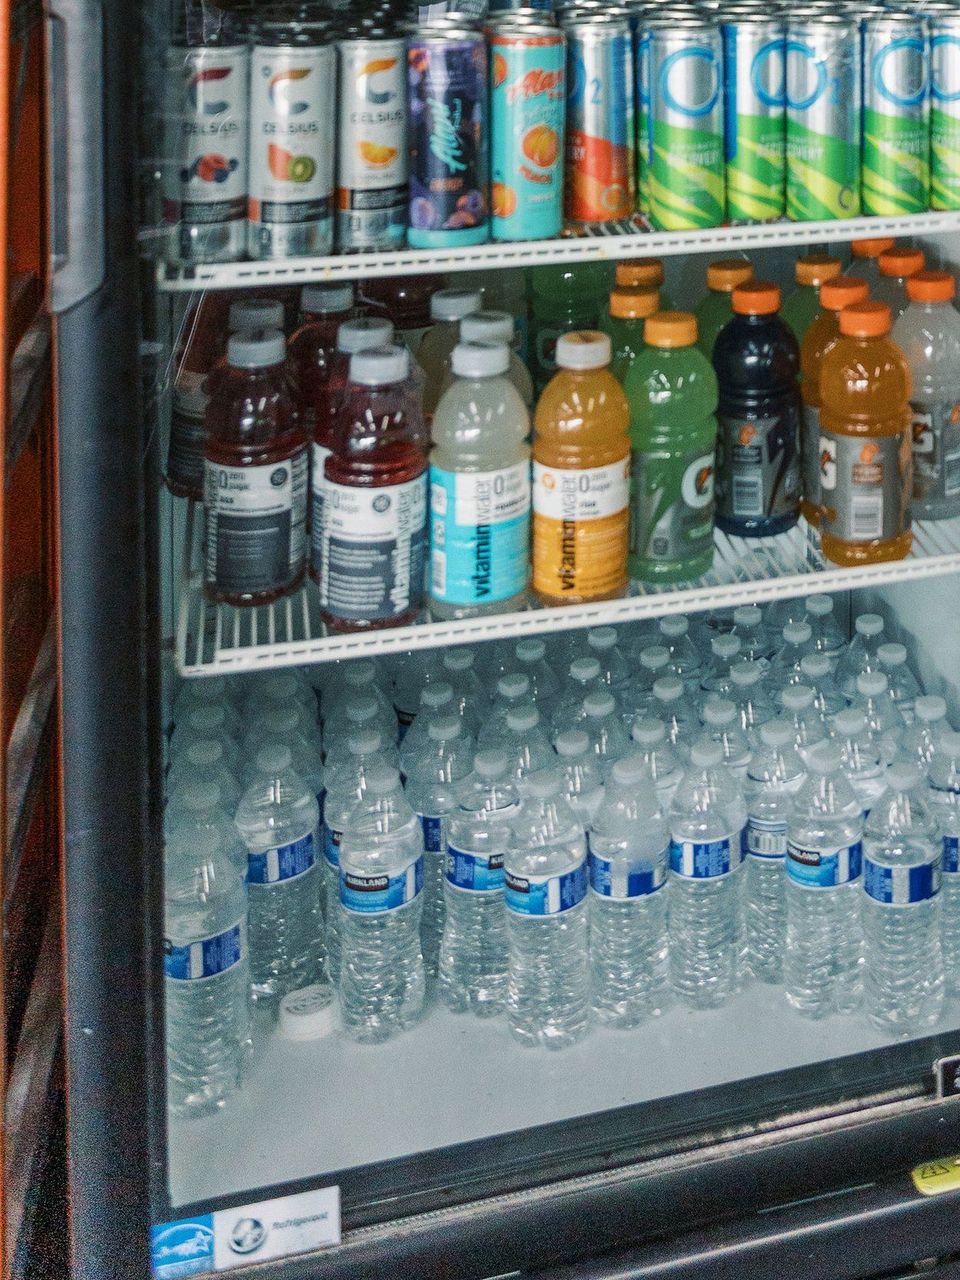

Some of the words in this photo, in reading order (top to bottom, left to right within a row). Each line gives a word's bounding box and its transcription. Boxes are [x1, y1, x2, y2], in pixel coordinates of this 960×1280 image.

[471, 480, 491, 598] vitaminwater
[558, 476, 577, 591] vitaminwater
[346, 874, 388, 888] KIRKLAND
